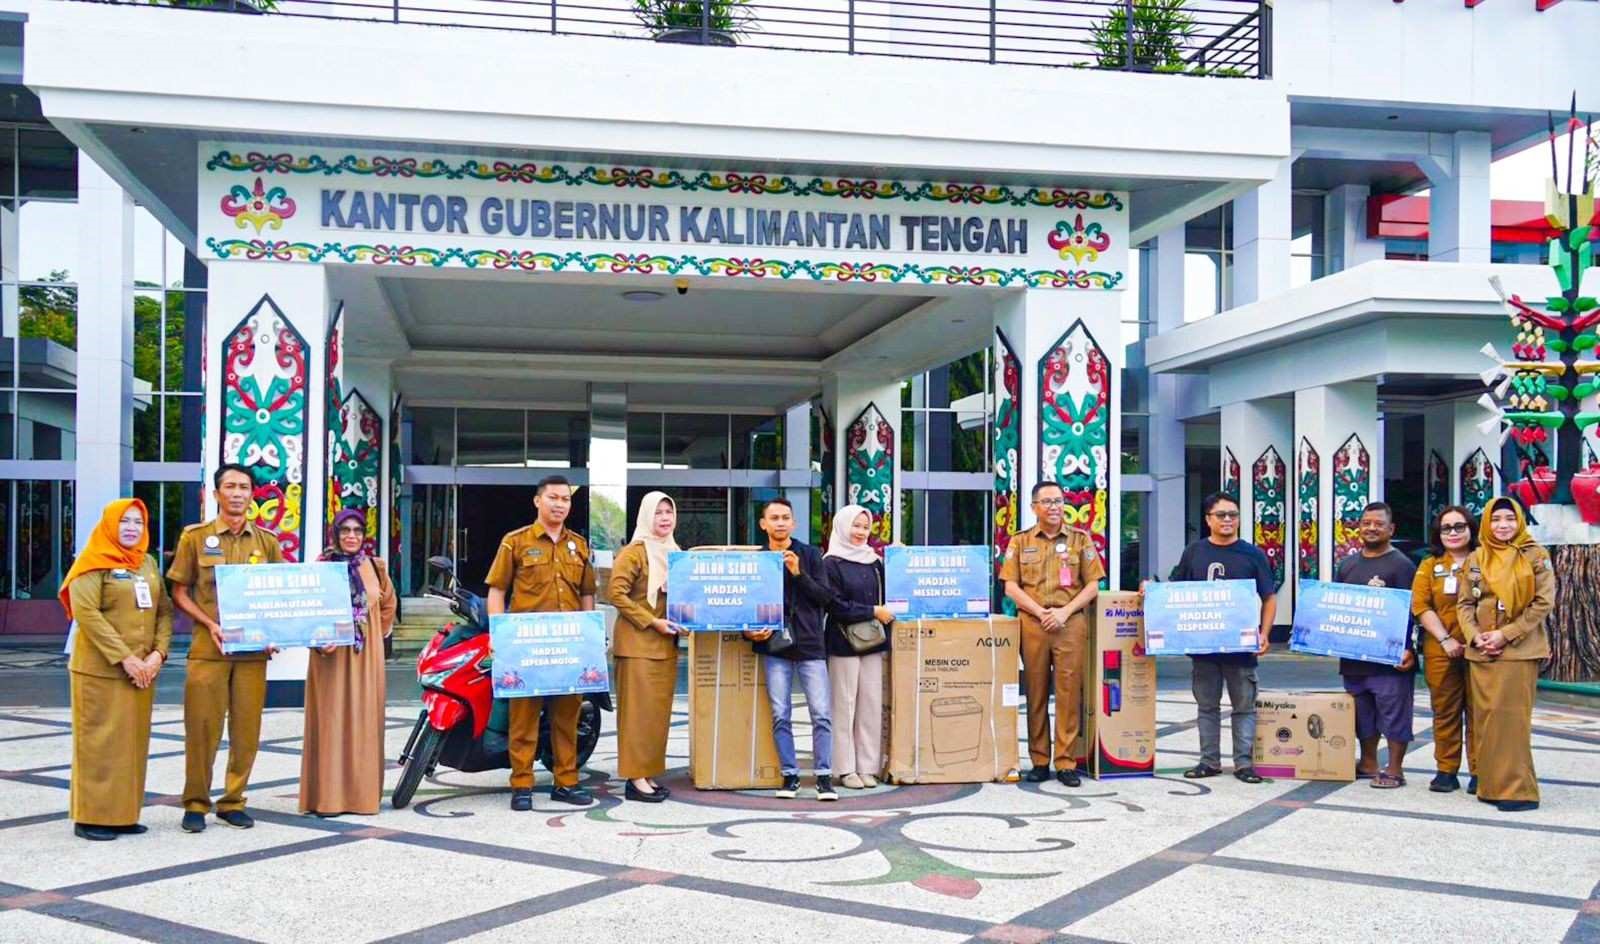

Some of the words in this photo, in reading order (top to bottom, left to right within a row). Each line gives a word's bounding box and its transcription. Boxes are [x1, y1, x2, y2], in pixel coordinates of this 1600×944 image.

[320, 189, 469, 234] KANTOR
[480, 197, 670, 242] GUBERNUR
[680, 206, 891, 250] KALIMANTAN
[901, 215, 1029, 254] TENGAH
[918, 577, 957, 585] HADIAH
[703, 584, 747, 594] HADIAH
[708, 598, 743, 606] KULKAS
[1114, 608, 1144, 620] Miyako
[1179, 612, 1222, 621] HADIAH
[1328, 614, 1372, 626] HADIAH
[976, 637, 1010, 647] AQUA
[532, 647, 568, 656] HADIAH
[1264, 701, 1296, 710] Miyako
